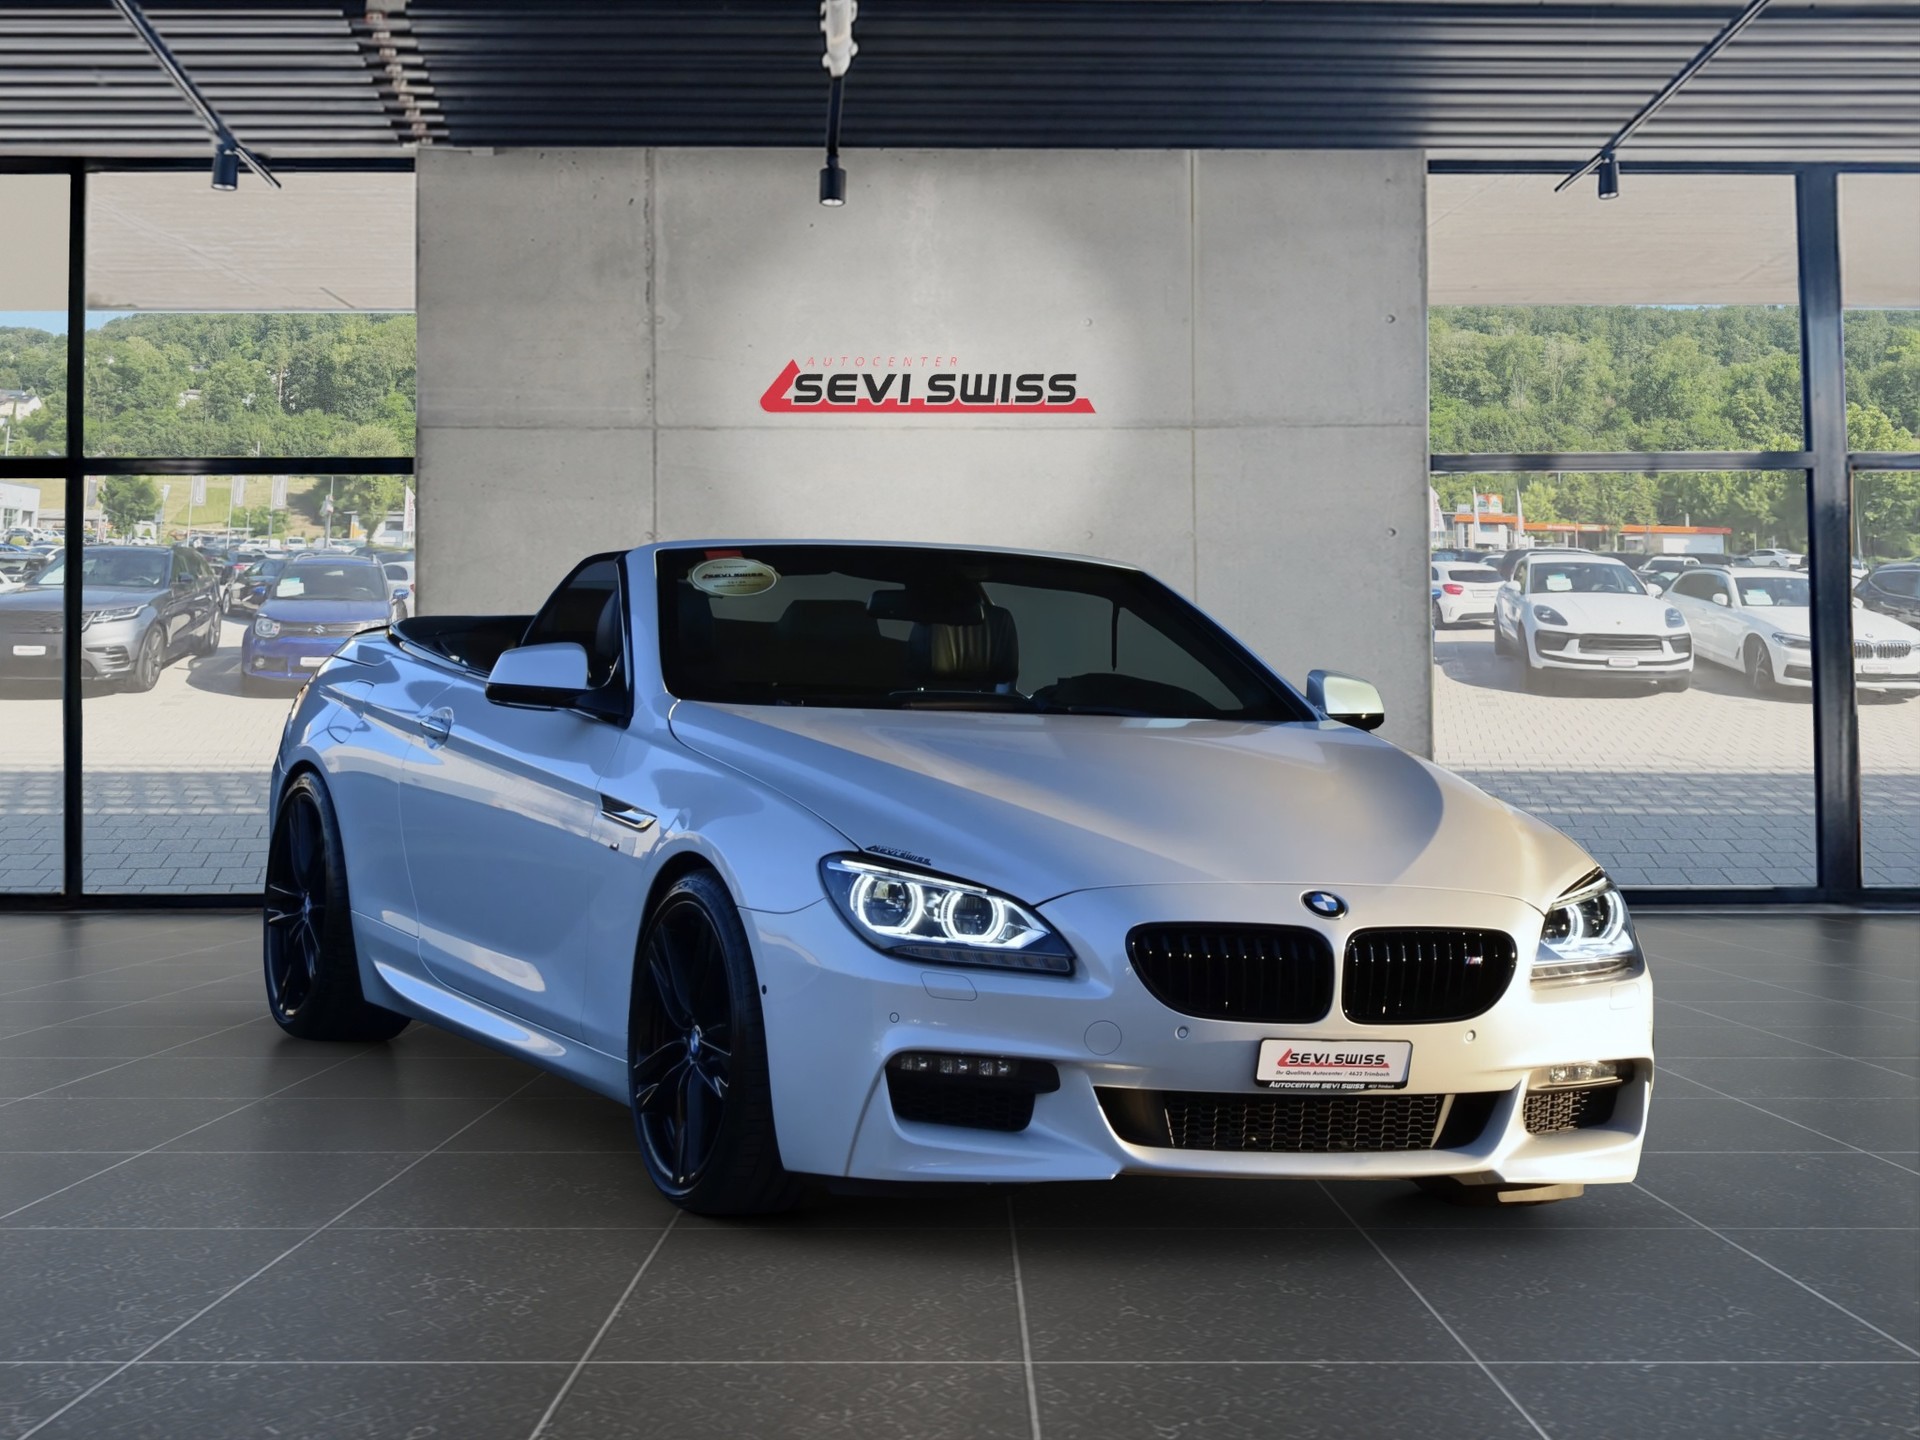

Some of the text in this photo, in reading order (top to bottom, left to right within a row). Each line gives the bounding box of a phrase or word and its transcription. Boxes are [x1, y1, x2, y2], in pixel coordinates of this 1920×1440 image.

[806, 356, 959, 368] AUTOCENTER
[793, 373, 1077, 403] SEVI SWISS
[1289, 1053, 1386, 1065] SEVI SWISS
